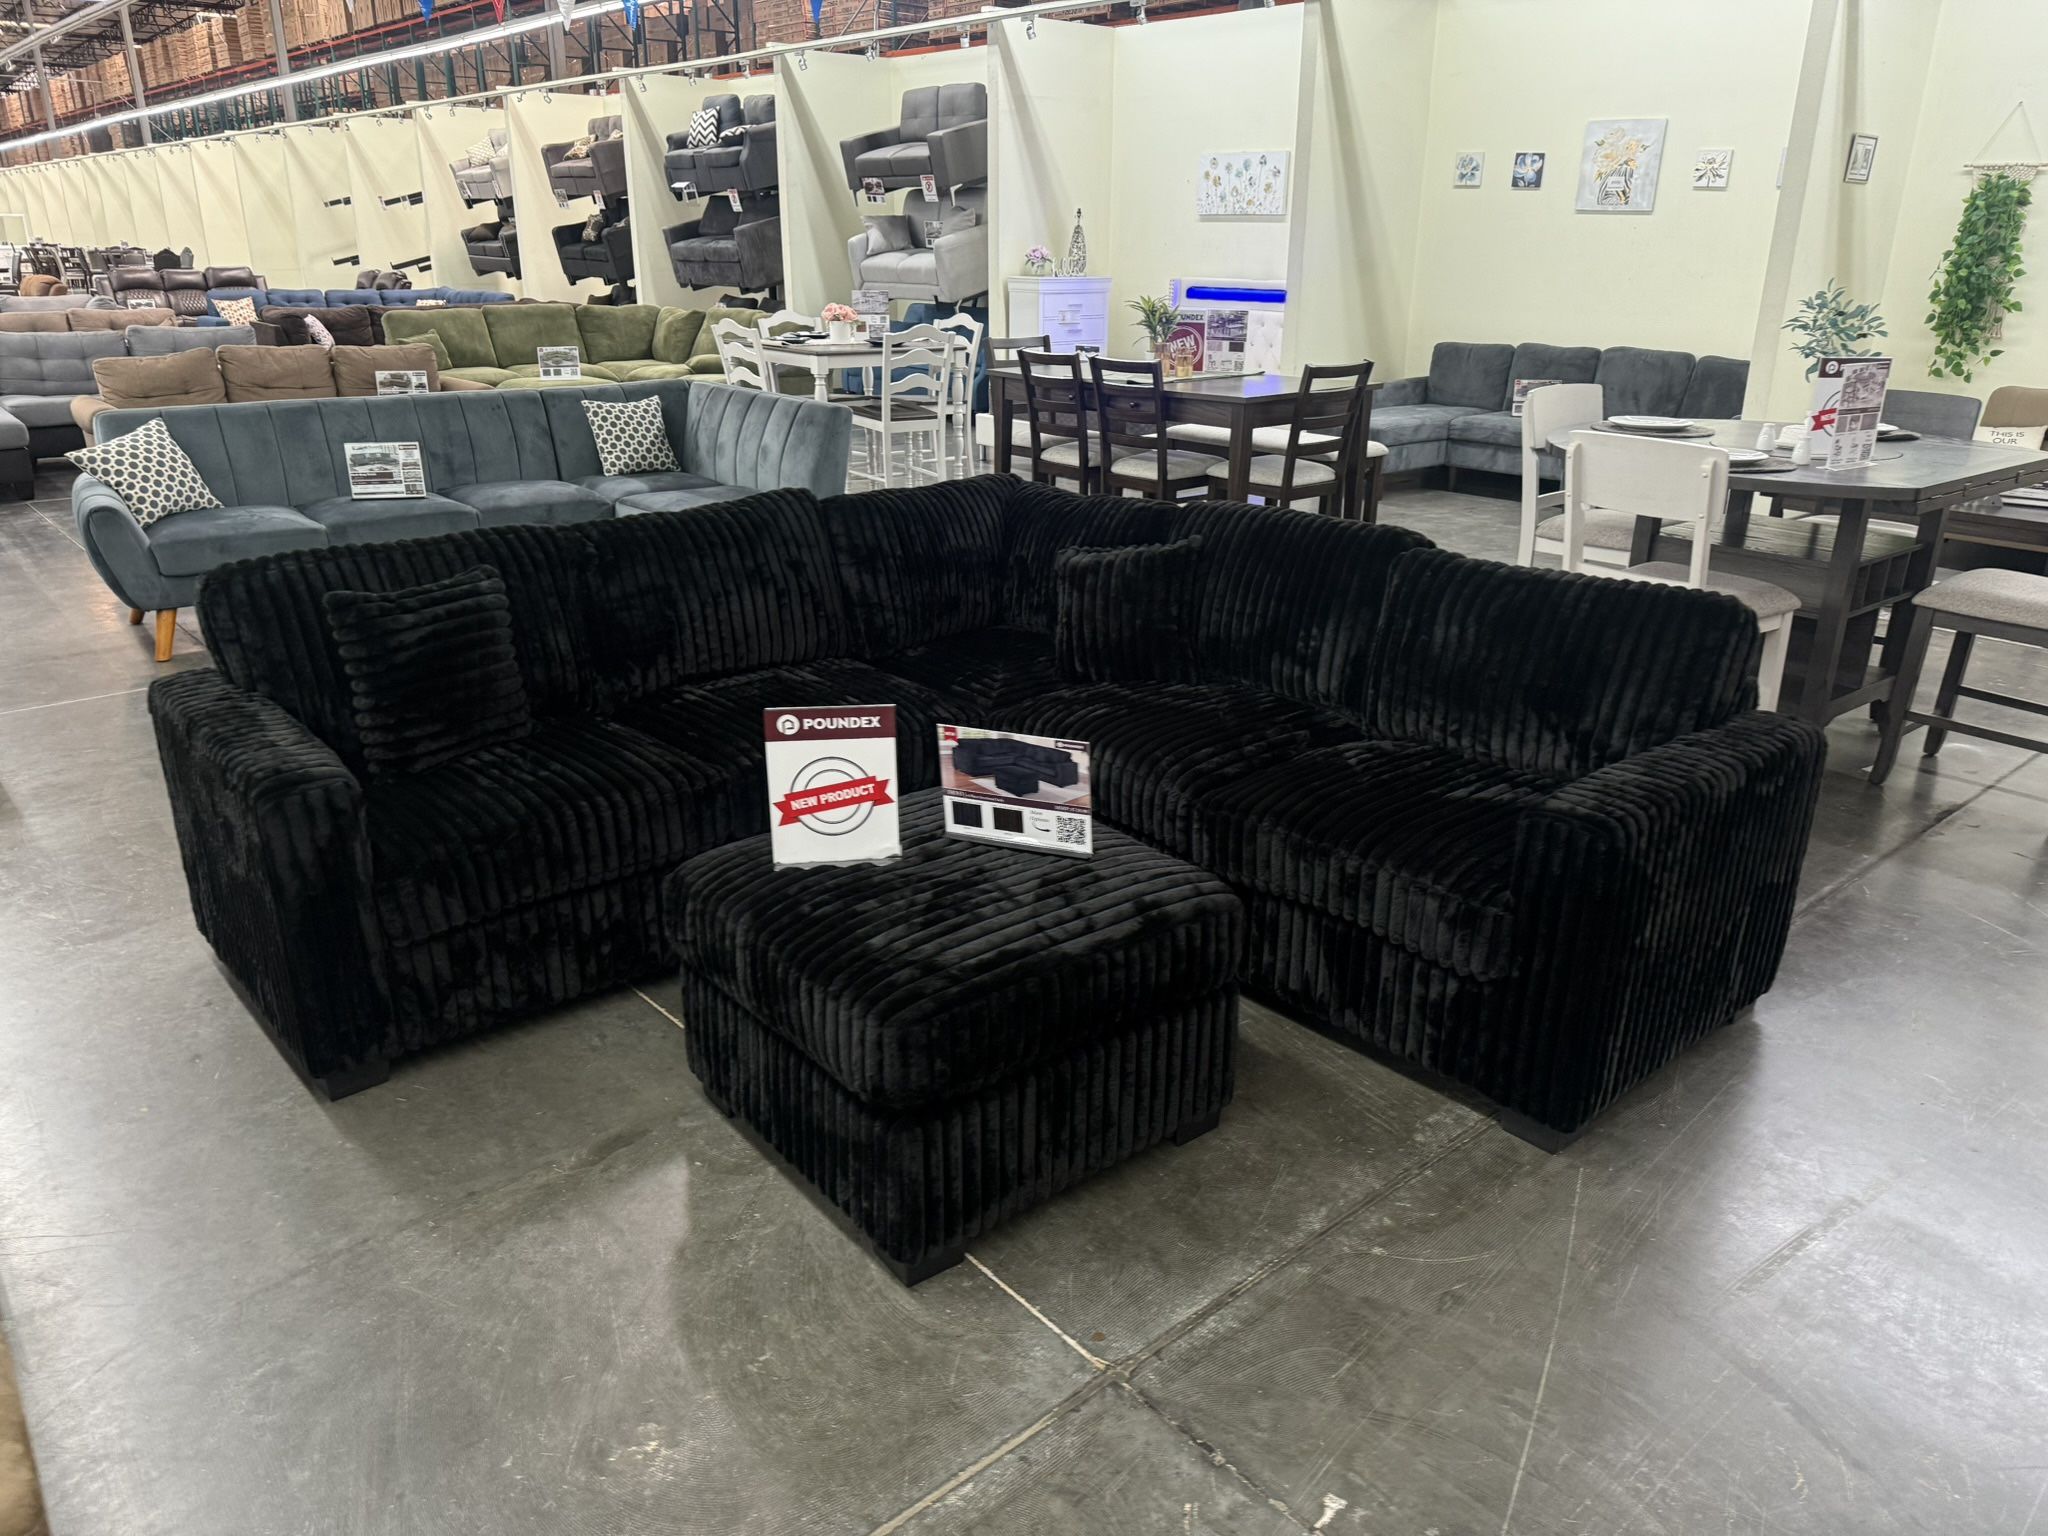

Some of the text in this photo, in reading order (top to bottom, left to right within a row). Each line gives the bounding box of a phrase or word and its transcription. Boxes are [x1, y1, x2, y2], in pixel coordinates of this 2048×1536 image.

[1170, 334, 1196, 353] NEW
[803, 716, 881, 729] POUNDEX
[790, 784, 875, 810] NEW PRODUCT
